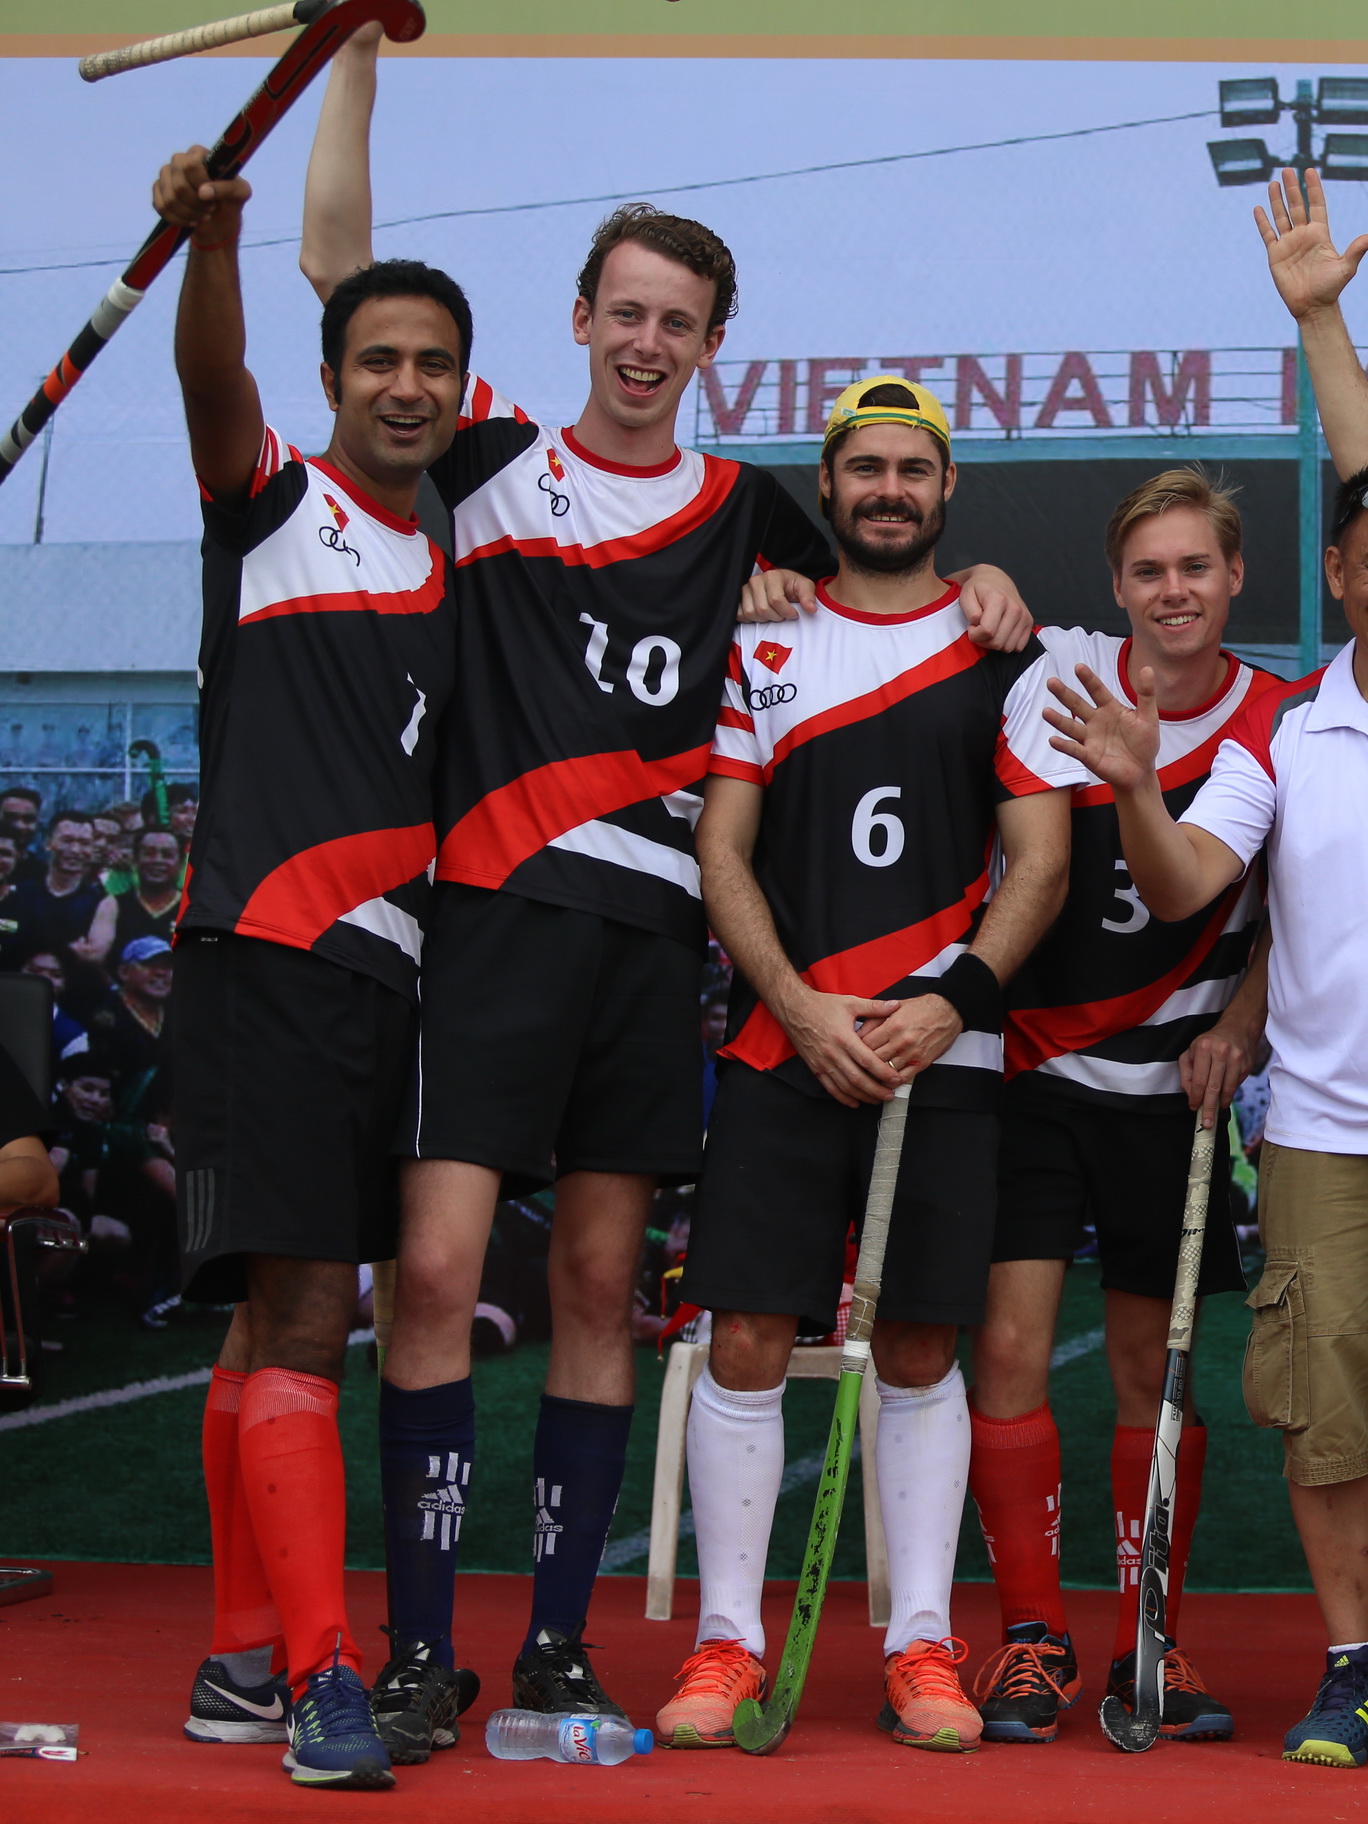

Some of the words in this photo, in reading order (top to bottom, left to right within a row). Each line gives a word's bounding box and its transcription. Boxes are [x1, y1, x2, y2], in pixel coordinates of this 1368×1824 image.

[701, 349, 1211, 436] VIETNAM
[851, 785, 905, 868] 6
[1101, 859, 1151, 934] 3
[417, 1500, 466, 1516] adidas
